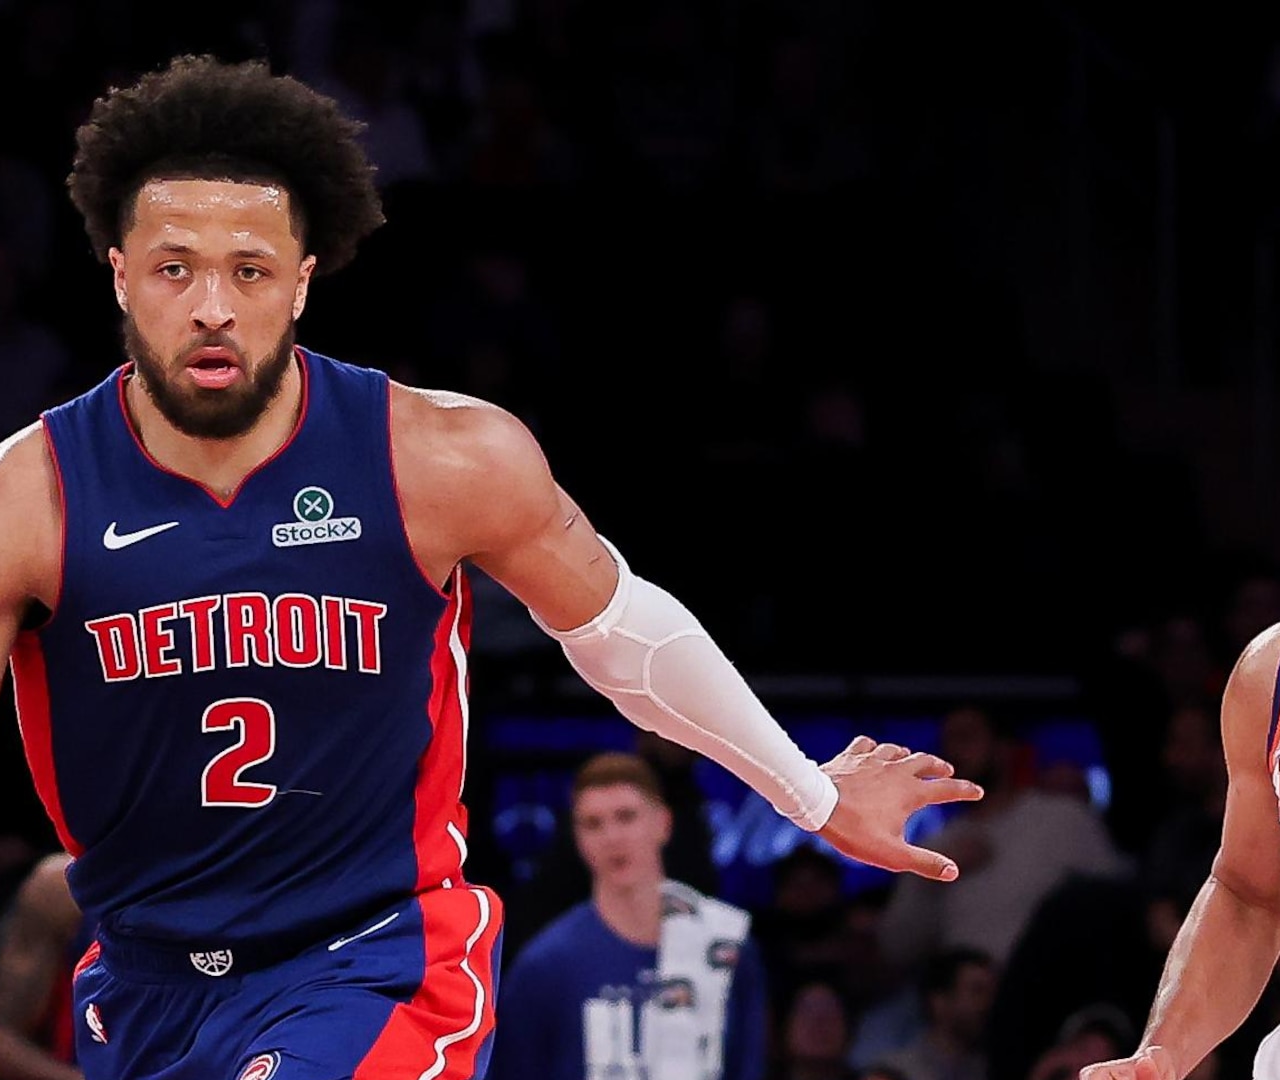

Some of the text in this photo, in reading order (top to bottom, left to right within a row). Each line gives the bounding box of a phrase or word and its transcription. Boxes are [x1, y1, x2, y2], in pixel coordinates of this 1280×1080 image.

[275, 520, 357, 543] StockX
[84, 591, 388, 683] DETROIT
[201, 696, 277, 809] 2
